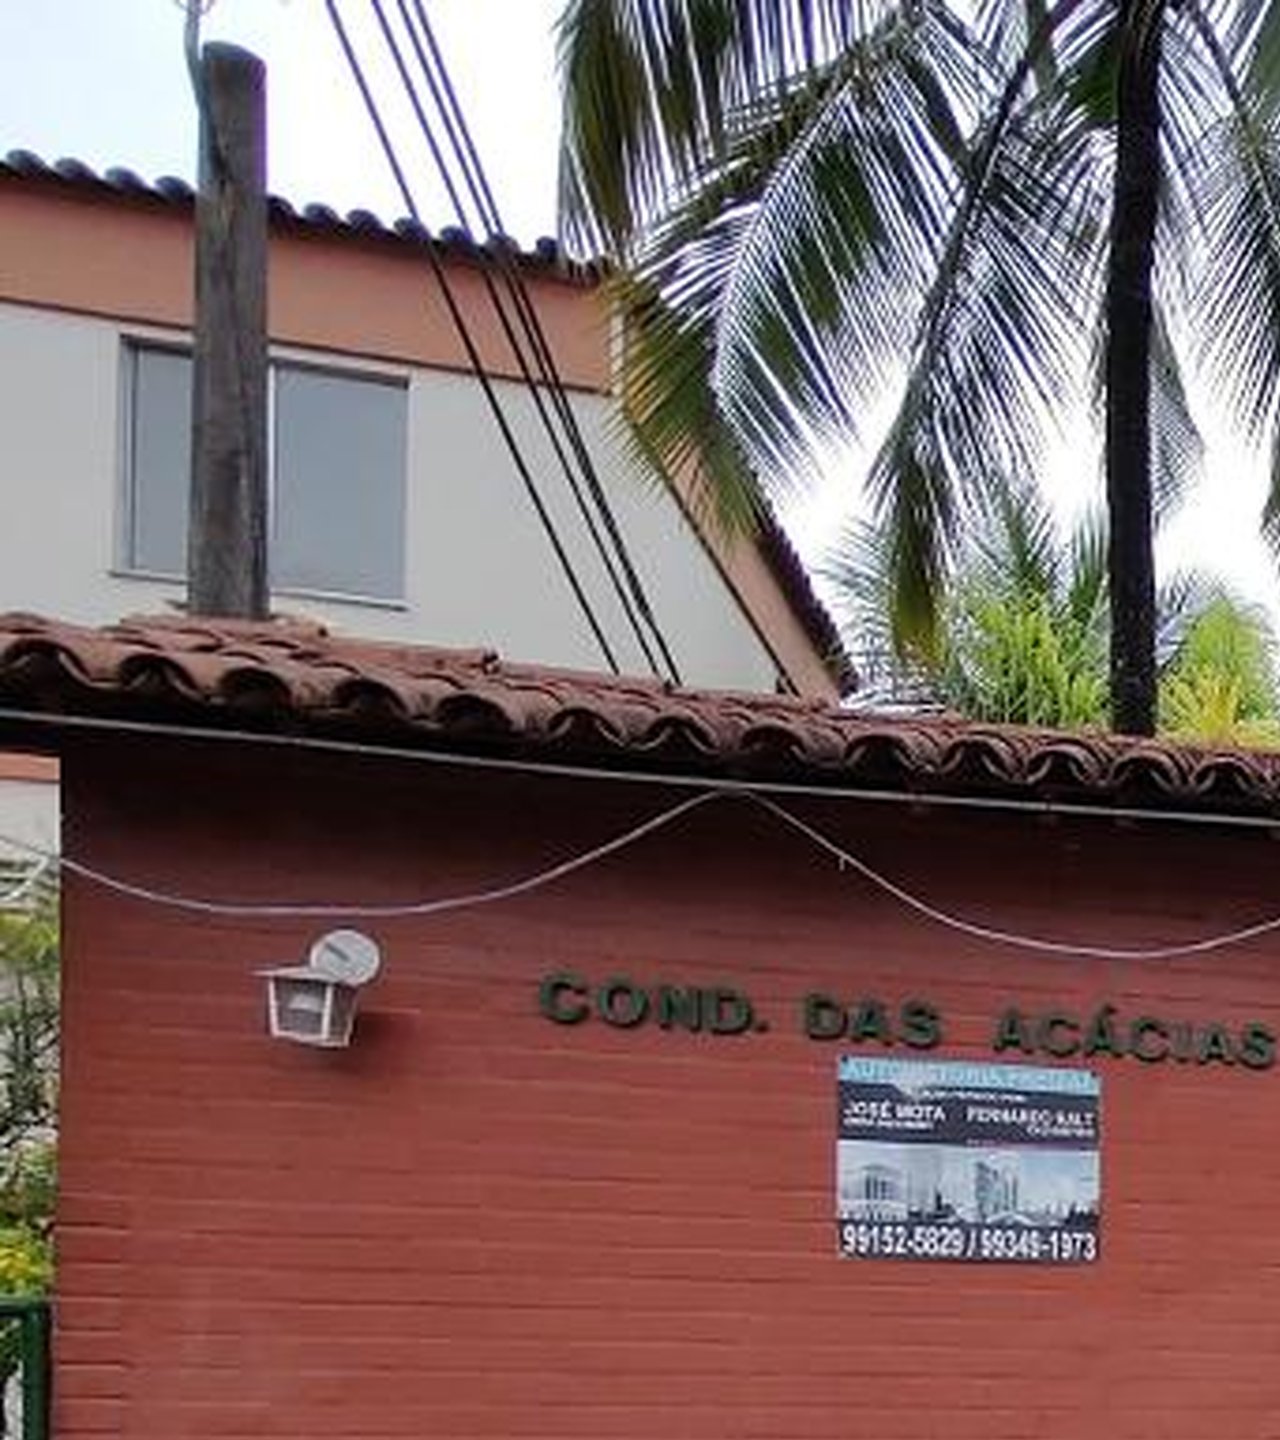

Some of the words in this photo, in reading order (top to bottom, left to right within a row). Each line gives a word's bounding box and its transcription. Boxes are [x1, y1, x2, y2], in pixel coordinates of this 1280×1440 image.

[539, 972, 769, 1035] COND.
[805, 993, 941, 1050] DAS
[993, 1003, 1277, 1069] ACÁCIAS
[843, 1100, 892, 1118] JOSÉ
